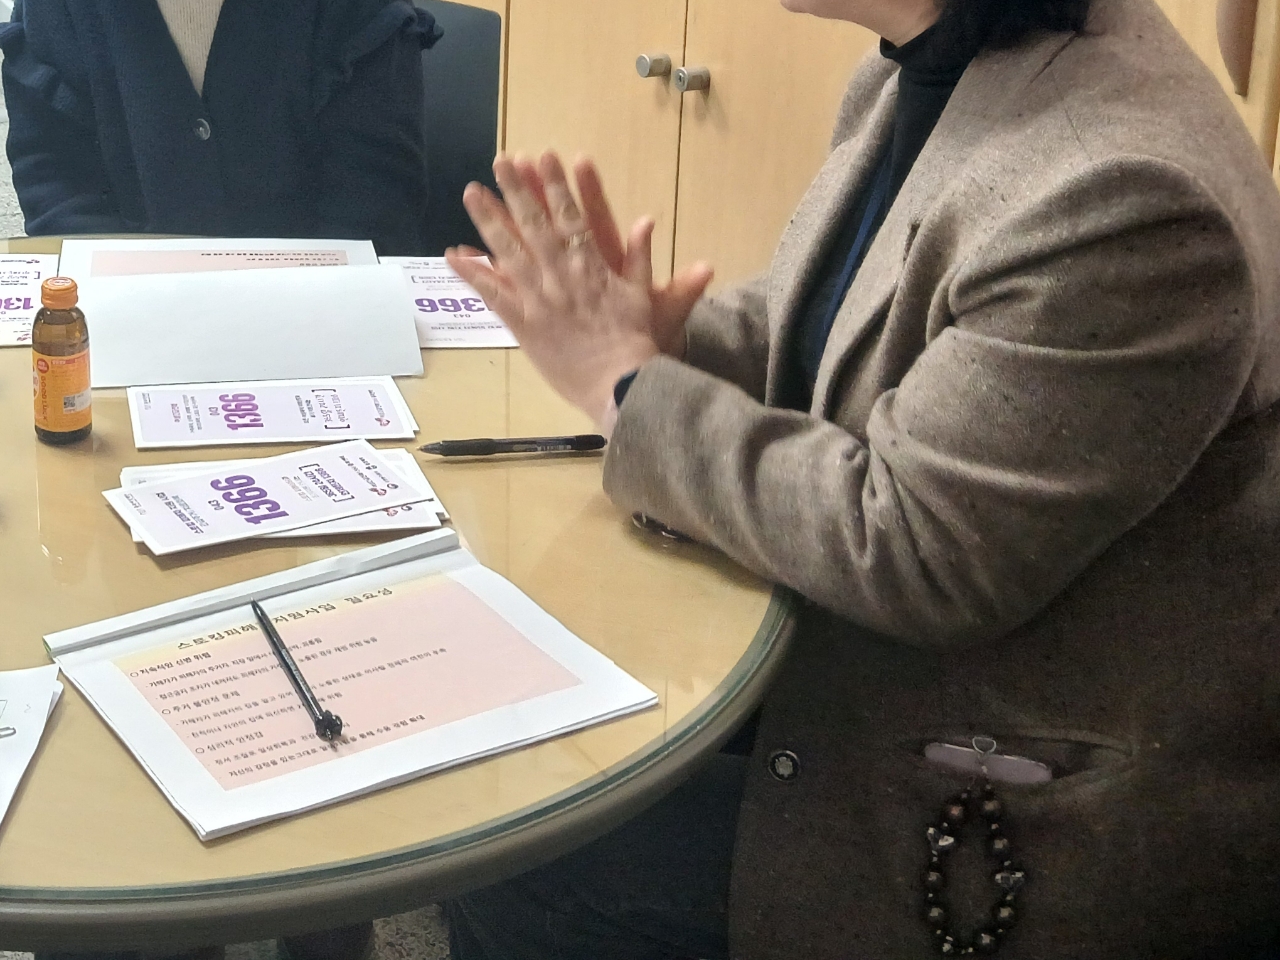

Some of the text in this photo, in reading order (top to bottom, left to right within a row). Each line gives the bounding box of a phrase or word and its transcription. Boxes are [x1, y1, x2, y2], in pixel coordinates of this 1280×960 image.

[219, 392, 264, 431] 1366
[210, 474, 289, 525] 1366
[344, 587, 393, 605] 필요성
